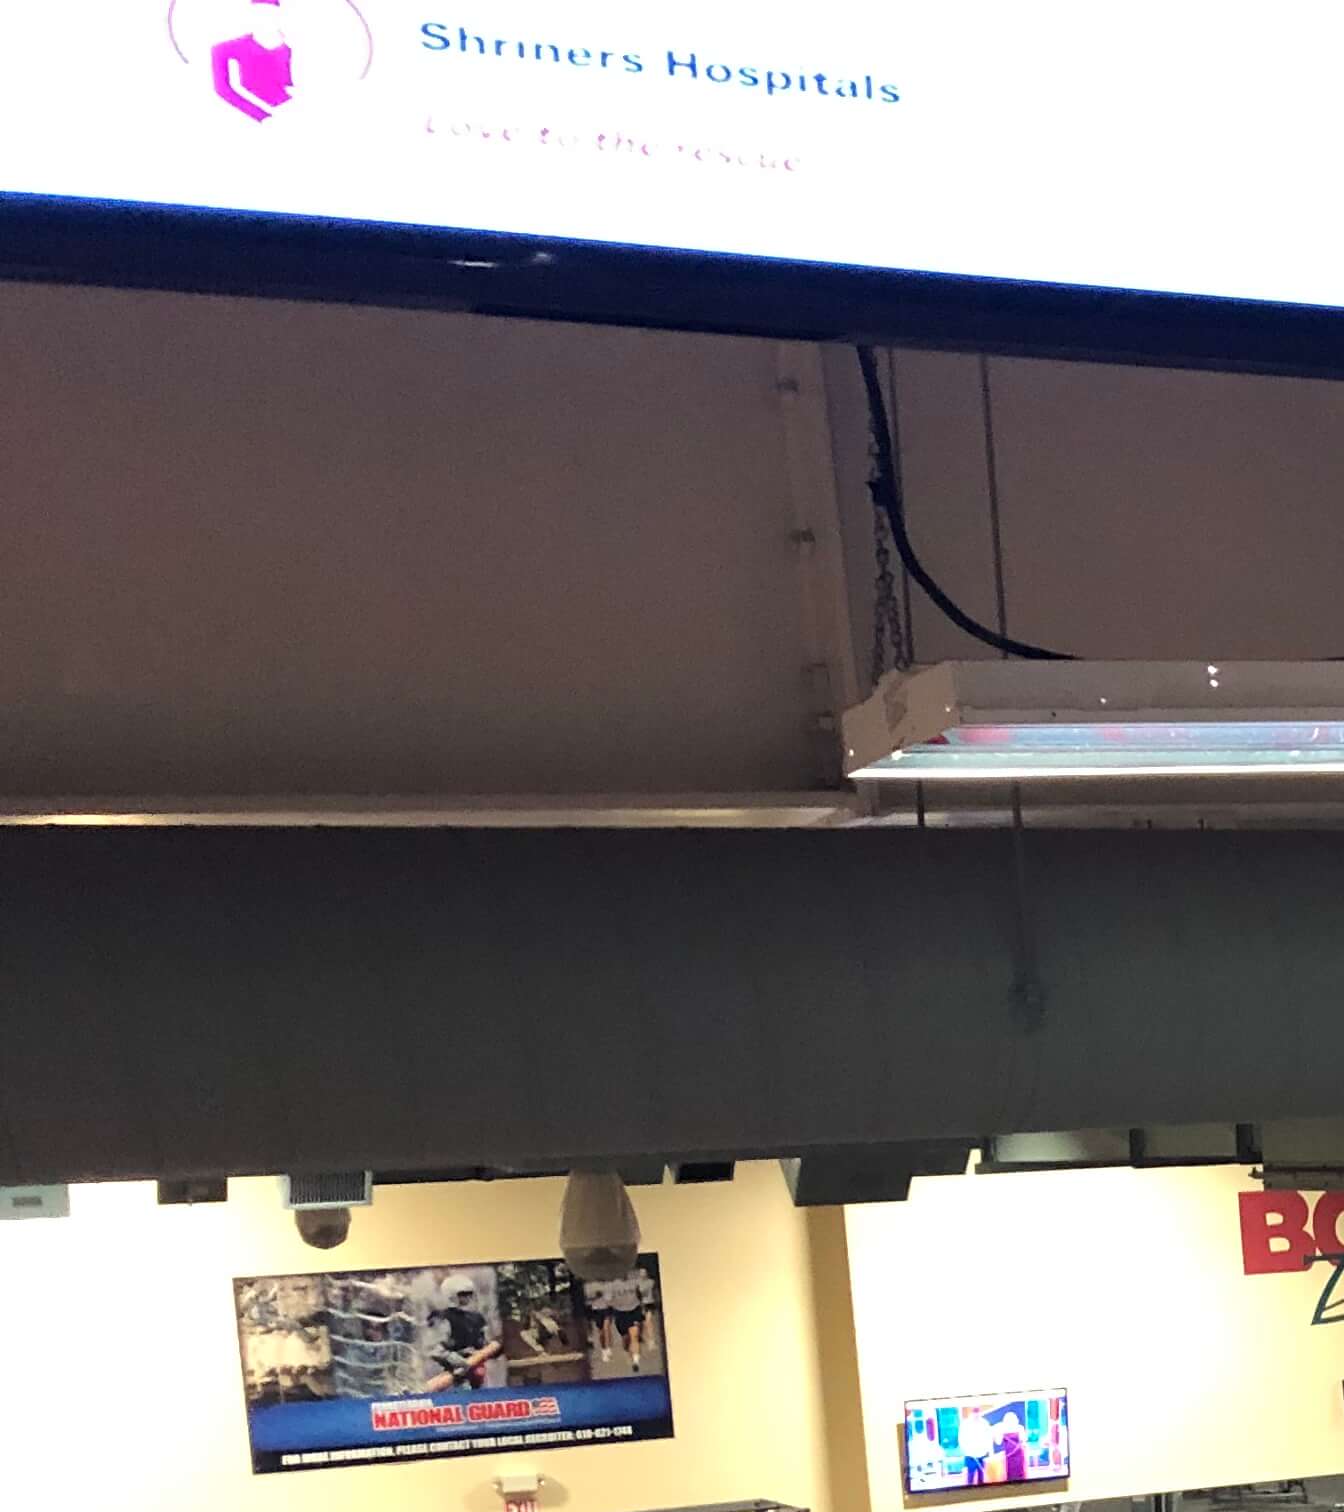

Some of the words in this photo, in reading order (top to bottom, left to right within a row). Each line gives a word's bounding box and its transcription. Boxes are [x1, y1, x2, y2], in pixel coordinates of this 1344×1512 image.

[420, 22, 643, 74] Shriners
[666, 50, 900, 103] Hospitals
[373, 1405, 464, 1430] NATIONAL
[469, 1401, 531, 1423] GUARD
